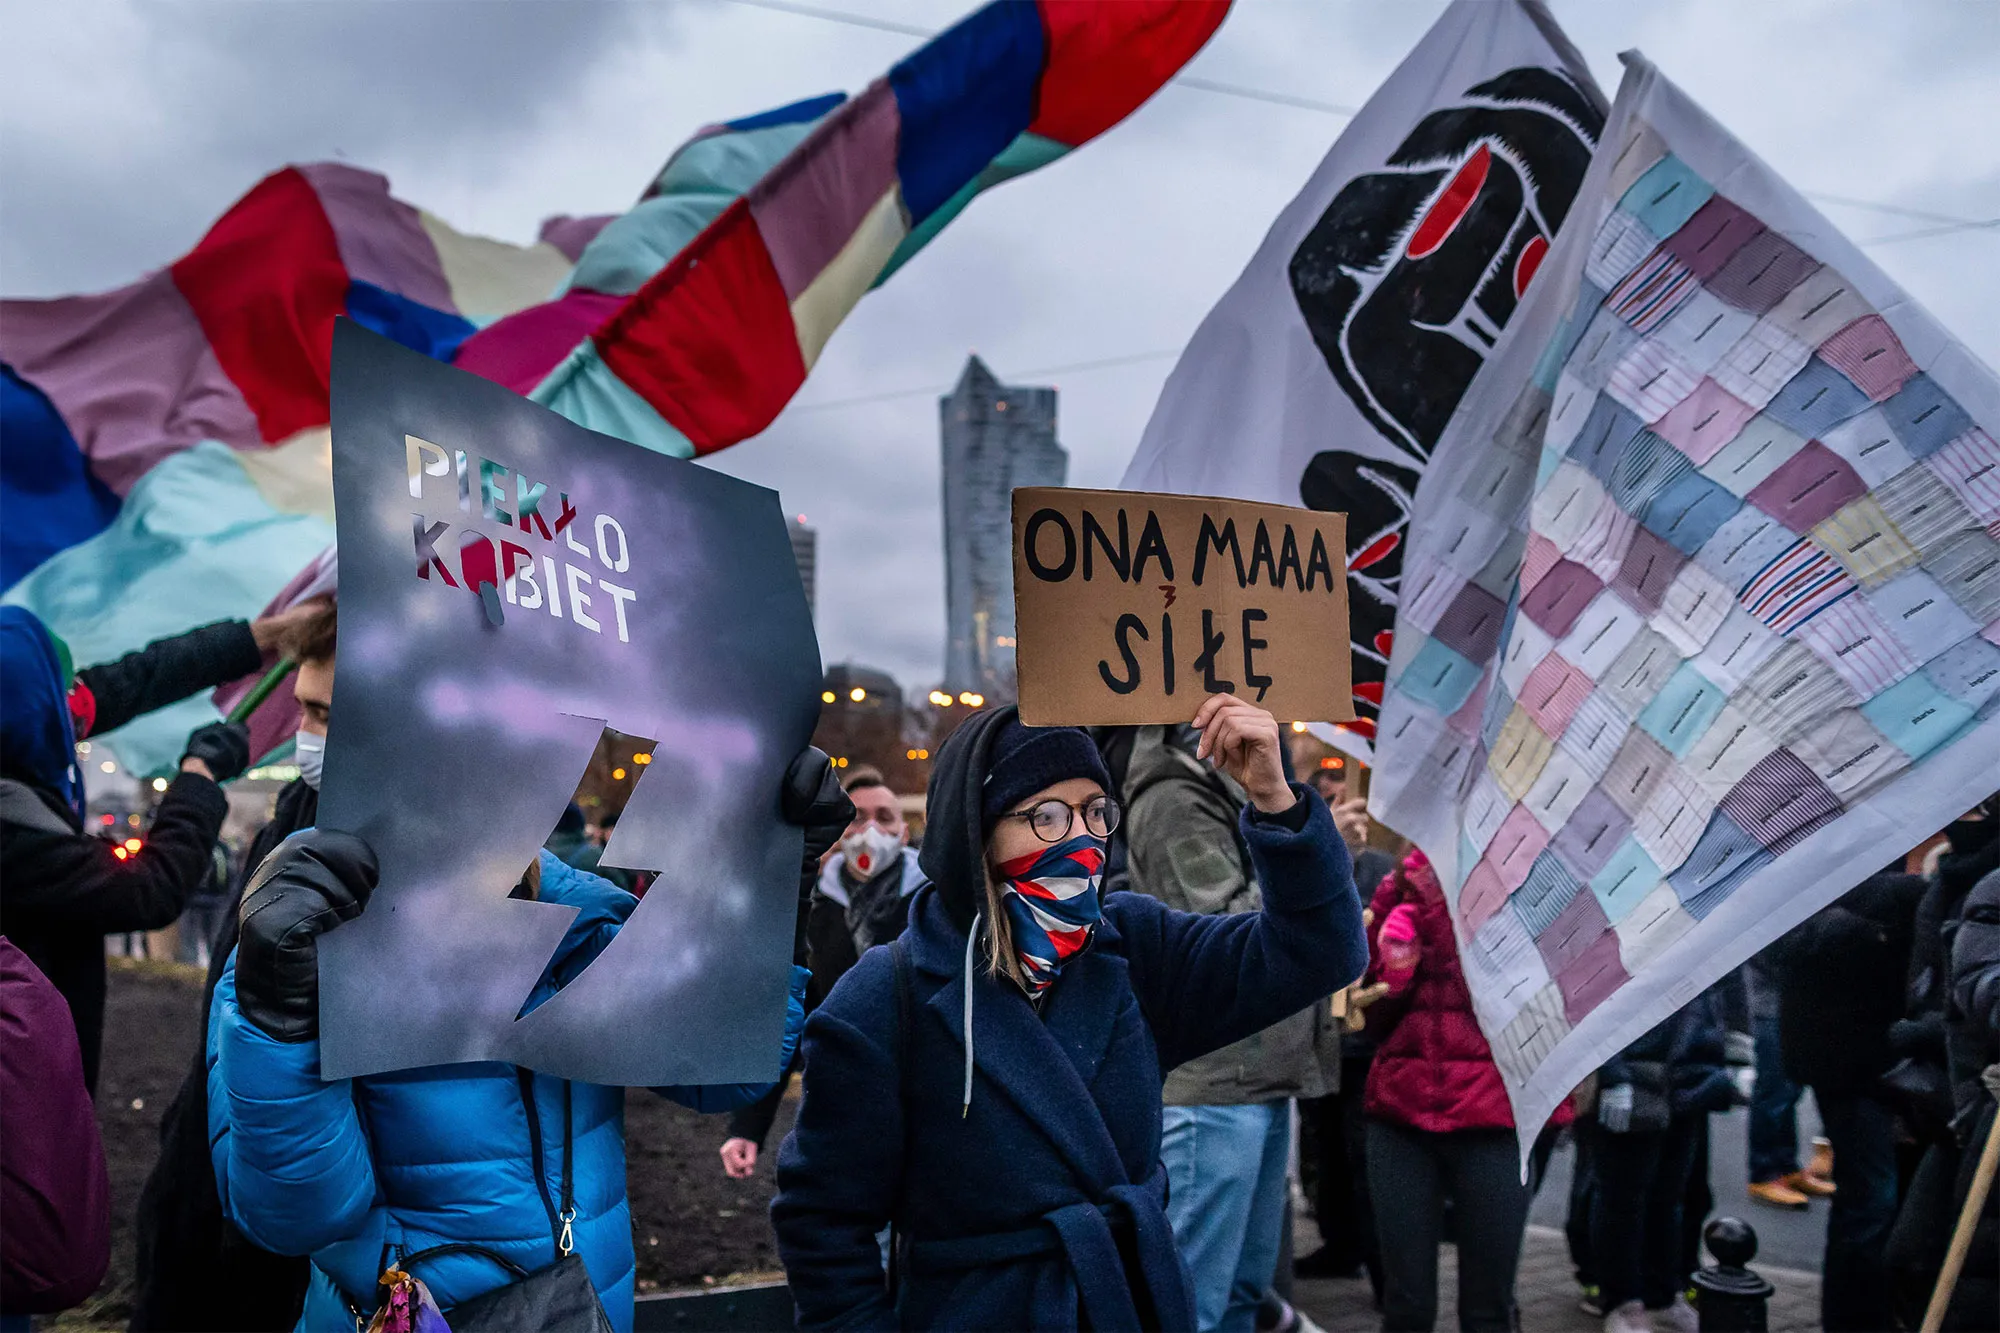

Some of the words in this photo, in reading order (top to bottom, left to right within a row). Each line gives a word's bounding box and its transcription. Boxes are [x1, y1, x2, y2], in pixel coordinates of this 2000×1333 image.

[405, 434, 629, 572] PIEKŁO
[1024, 508, 1174, 584] ONA
[1192, 513, 1334, 594] MAAA
[411, 513, 636, 642] KOBIET
[1098, 609, 1273, 702] SIŁĘ
